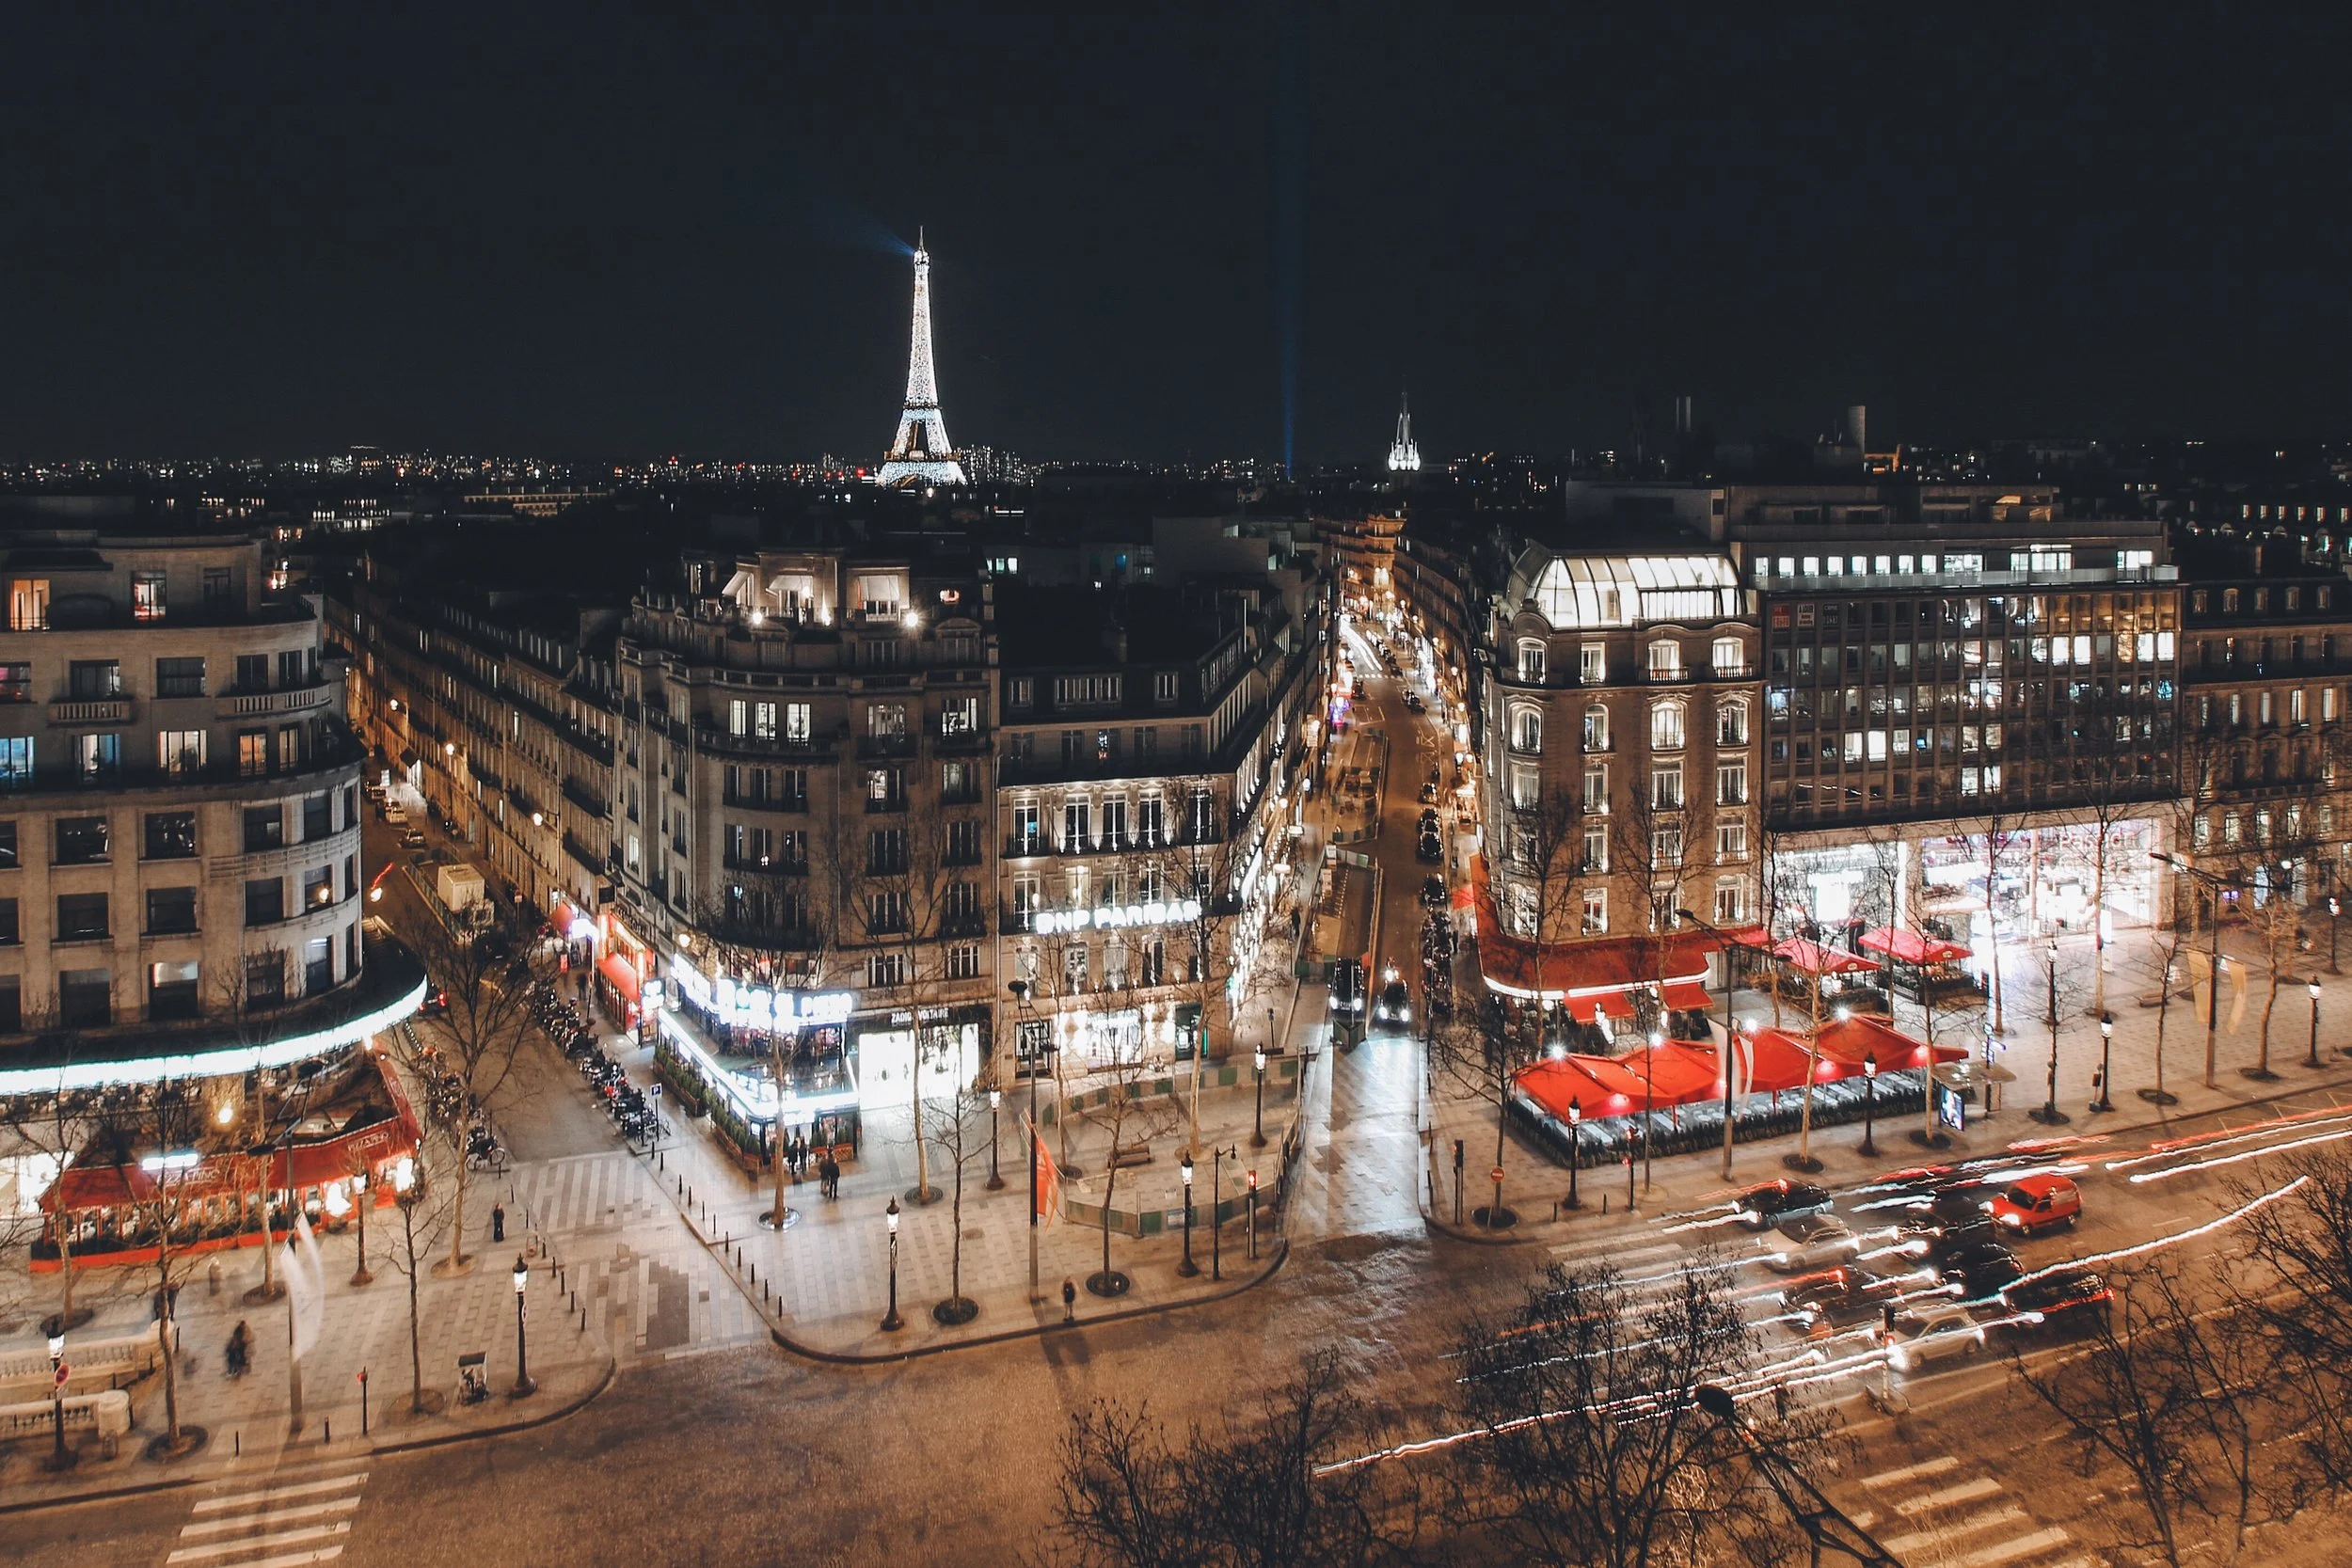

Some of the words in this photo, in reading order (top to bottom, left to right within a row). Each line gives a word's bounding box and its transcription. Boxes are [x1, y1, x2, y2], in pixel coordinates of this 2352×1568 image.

[1036, 910, 1090, 934] BNP
[1094, 900, 1200, 928] PARIBAS
[918, 1007, 948, 1022] VOLTAIRE
